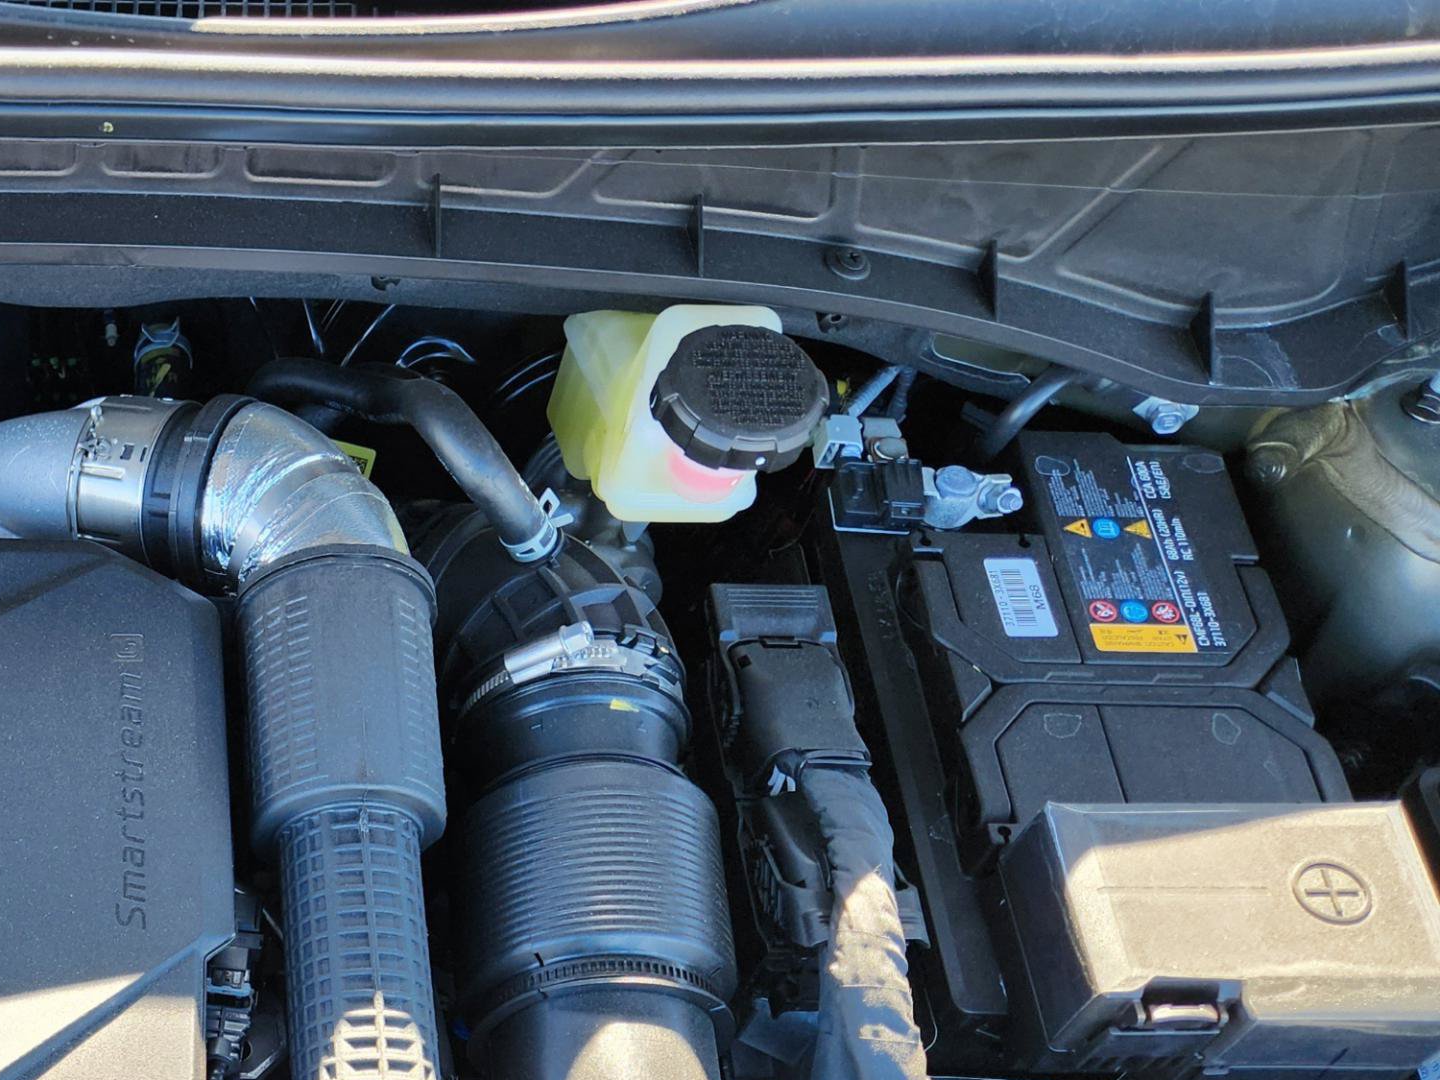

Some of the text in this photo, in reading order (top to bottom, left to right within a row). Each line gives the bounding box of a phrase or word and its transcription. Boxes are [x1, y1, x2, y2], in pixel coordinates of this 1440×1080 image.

[1151, 509, 1180, 560] 68Ah (20HR)
[1028, 584, 1048, 611] M68
[115, 671, 147, 929] Smartstream
